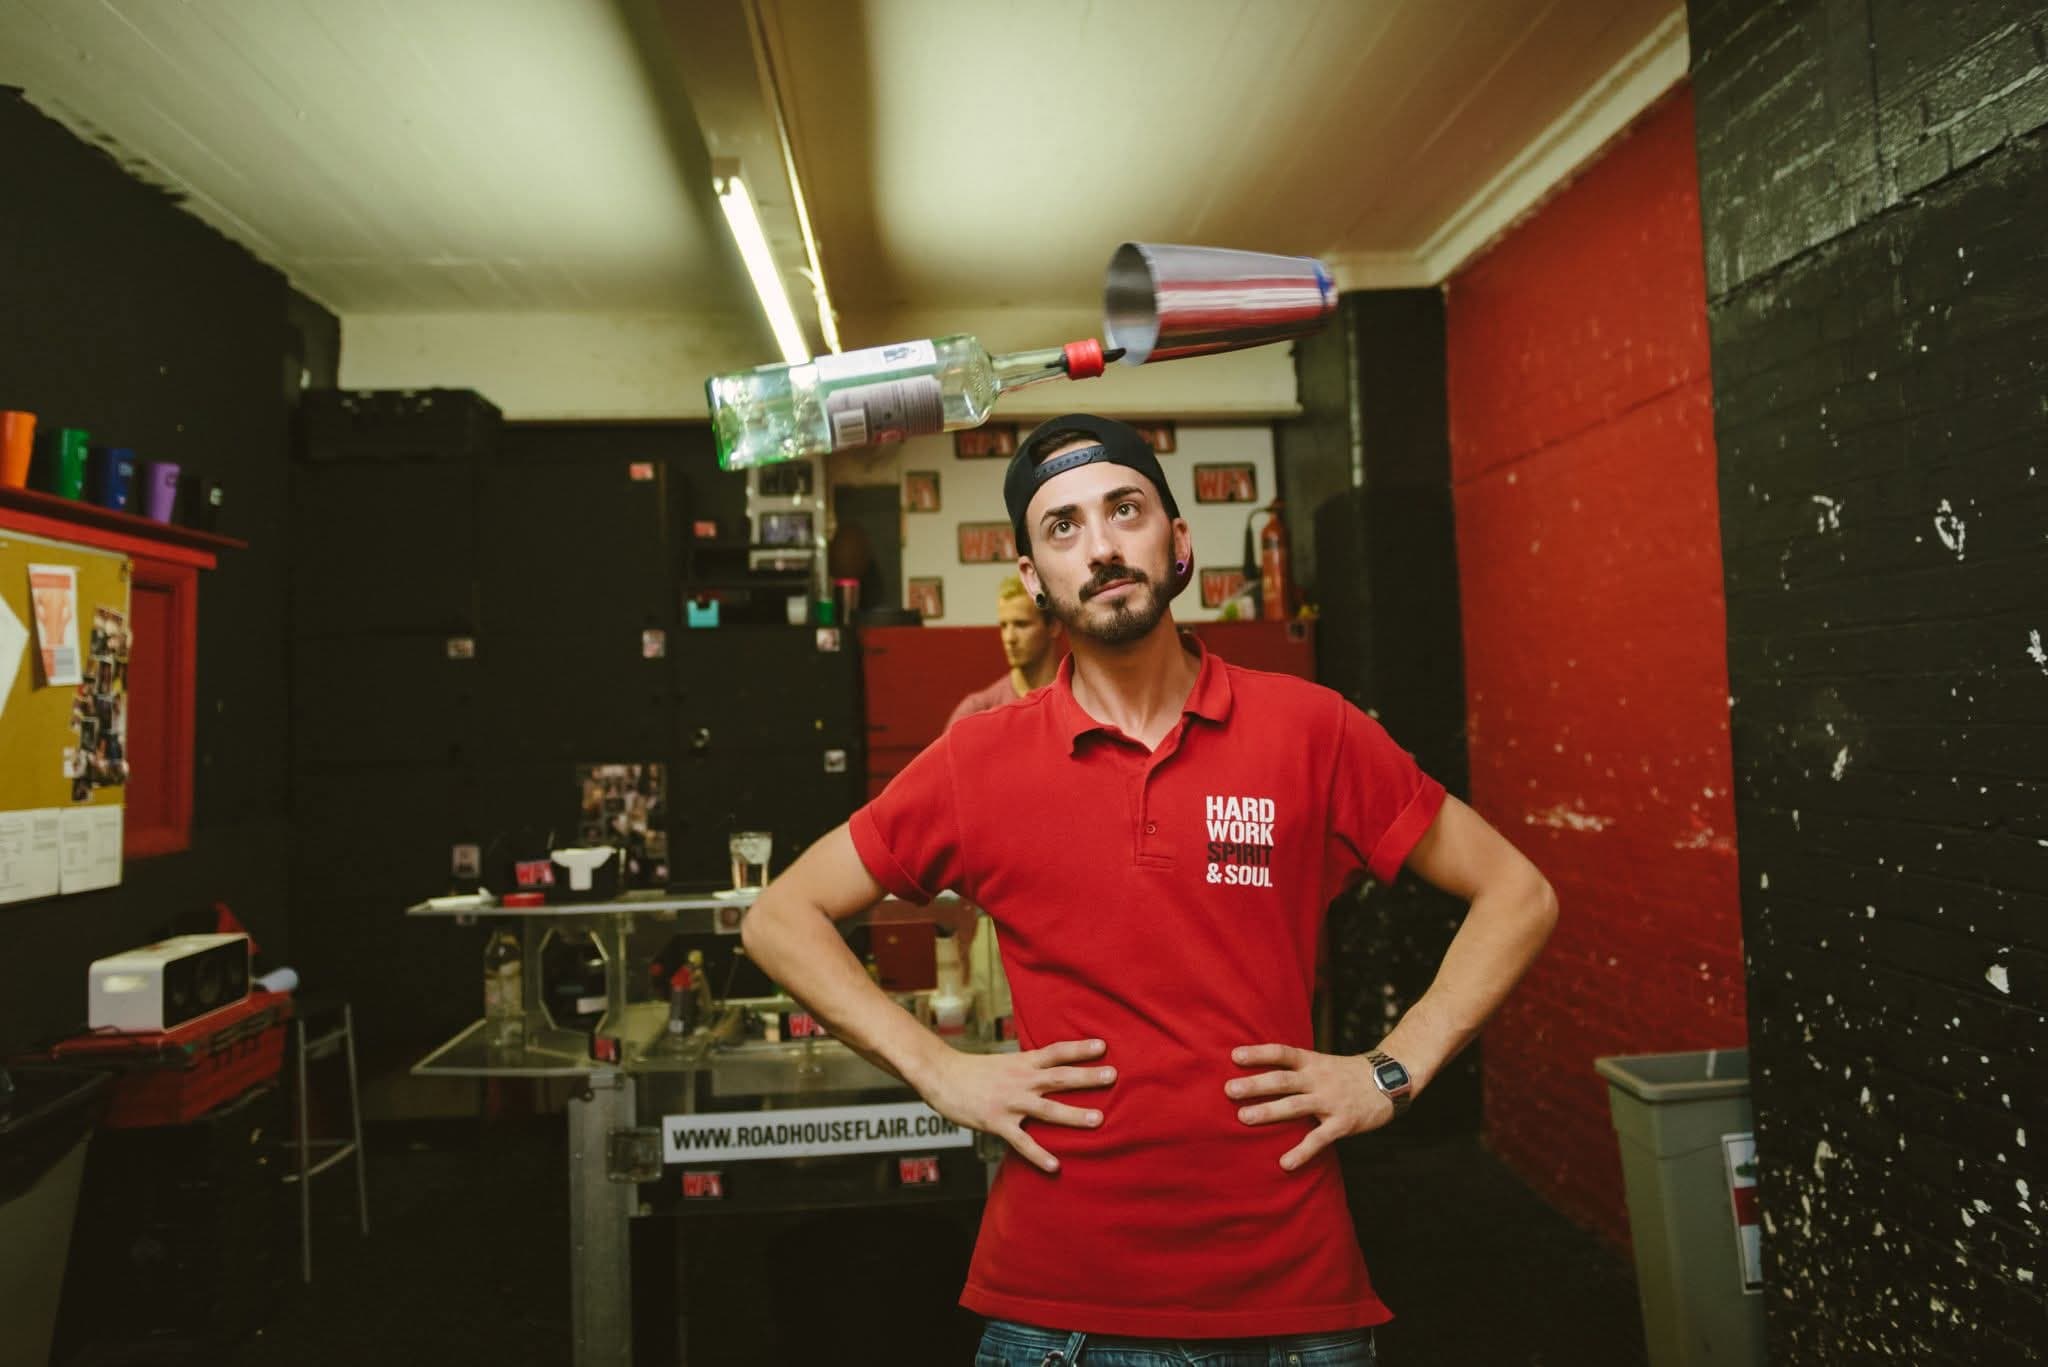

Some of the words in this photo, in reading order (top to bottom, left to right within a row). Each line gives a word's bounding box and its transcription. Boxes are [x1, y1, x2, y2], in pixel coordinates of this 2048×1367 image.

[1206, 796, 1275, 822] HARD
[1206, 820, 1275, 846] WORK
[1207, 843, 1273, 865] SPIRIT
[1206, 863, 1222, 883] &
[1224, 864, 1273, 887] SOUL
[673, 1115, 959, 1150] WWW.ROADHOUSEFLAIR.COM
